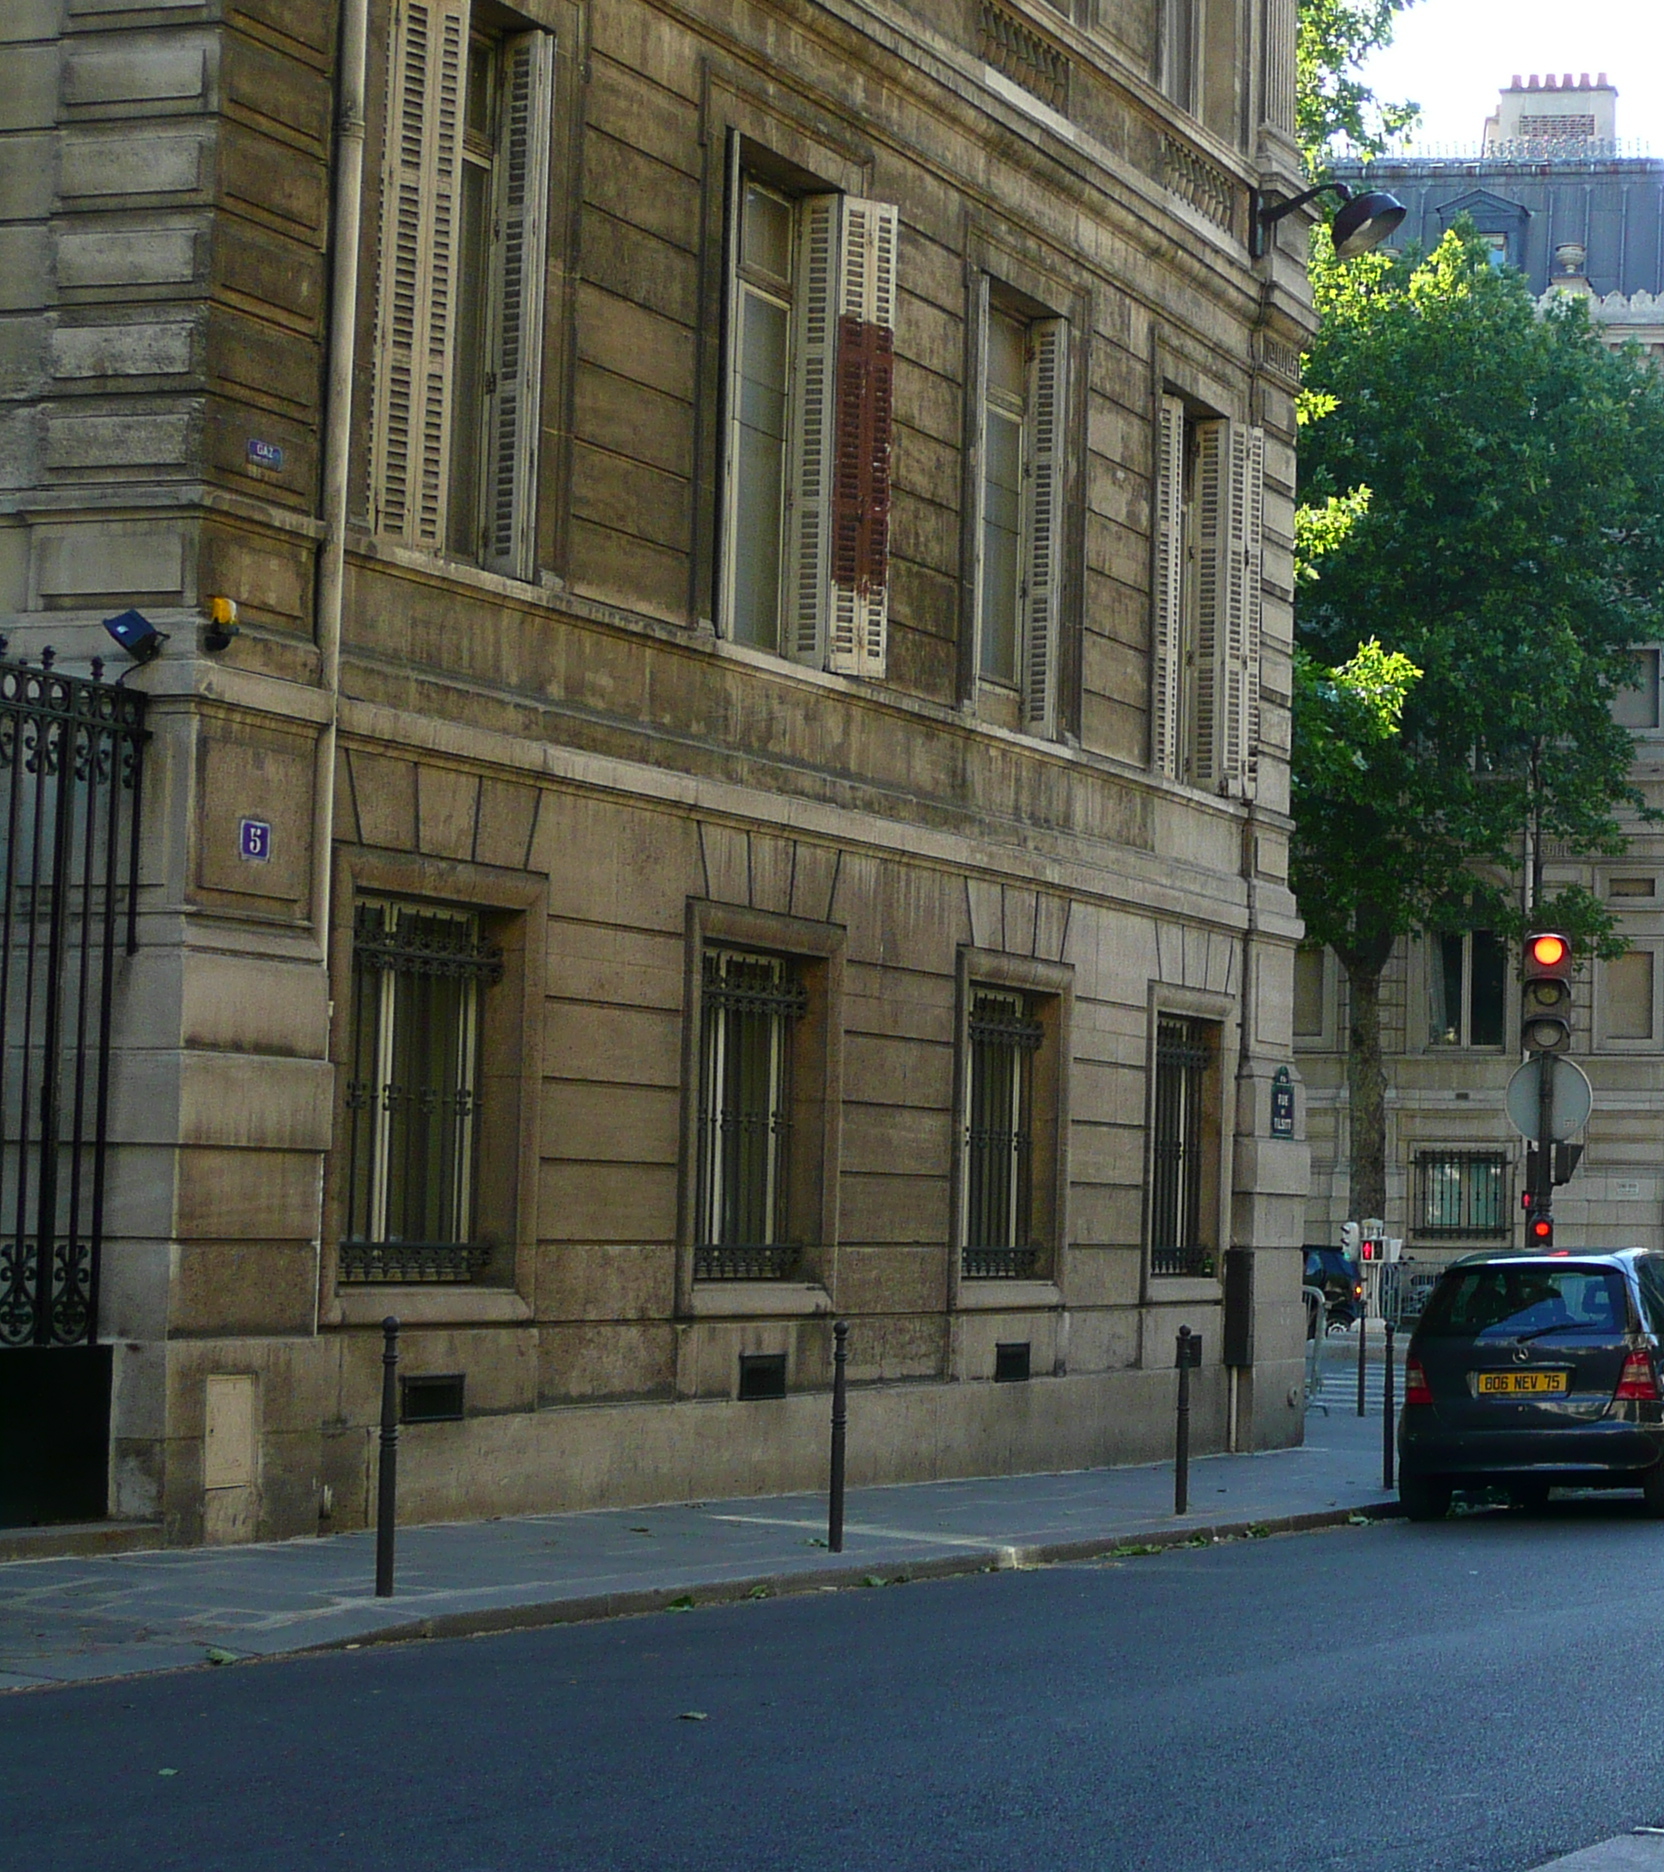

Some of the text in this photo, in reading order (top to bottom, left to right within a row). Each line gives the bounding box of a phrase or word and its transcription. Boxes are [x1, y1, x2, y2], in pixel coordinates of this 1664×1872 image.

[249, 827, 262, 854] 5
[1484, 1374, 1560, 1391] 806 NEV 75
